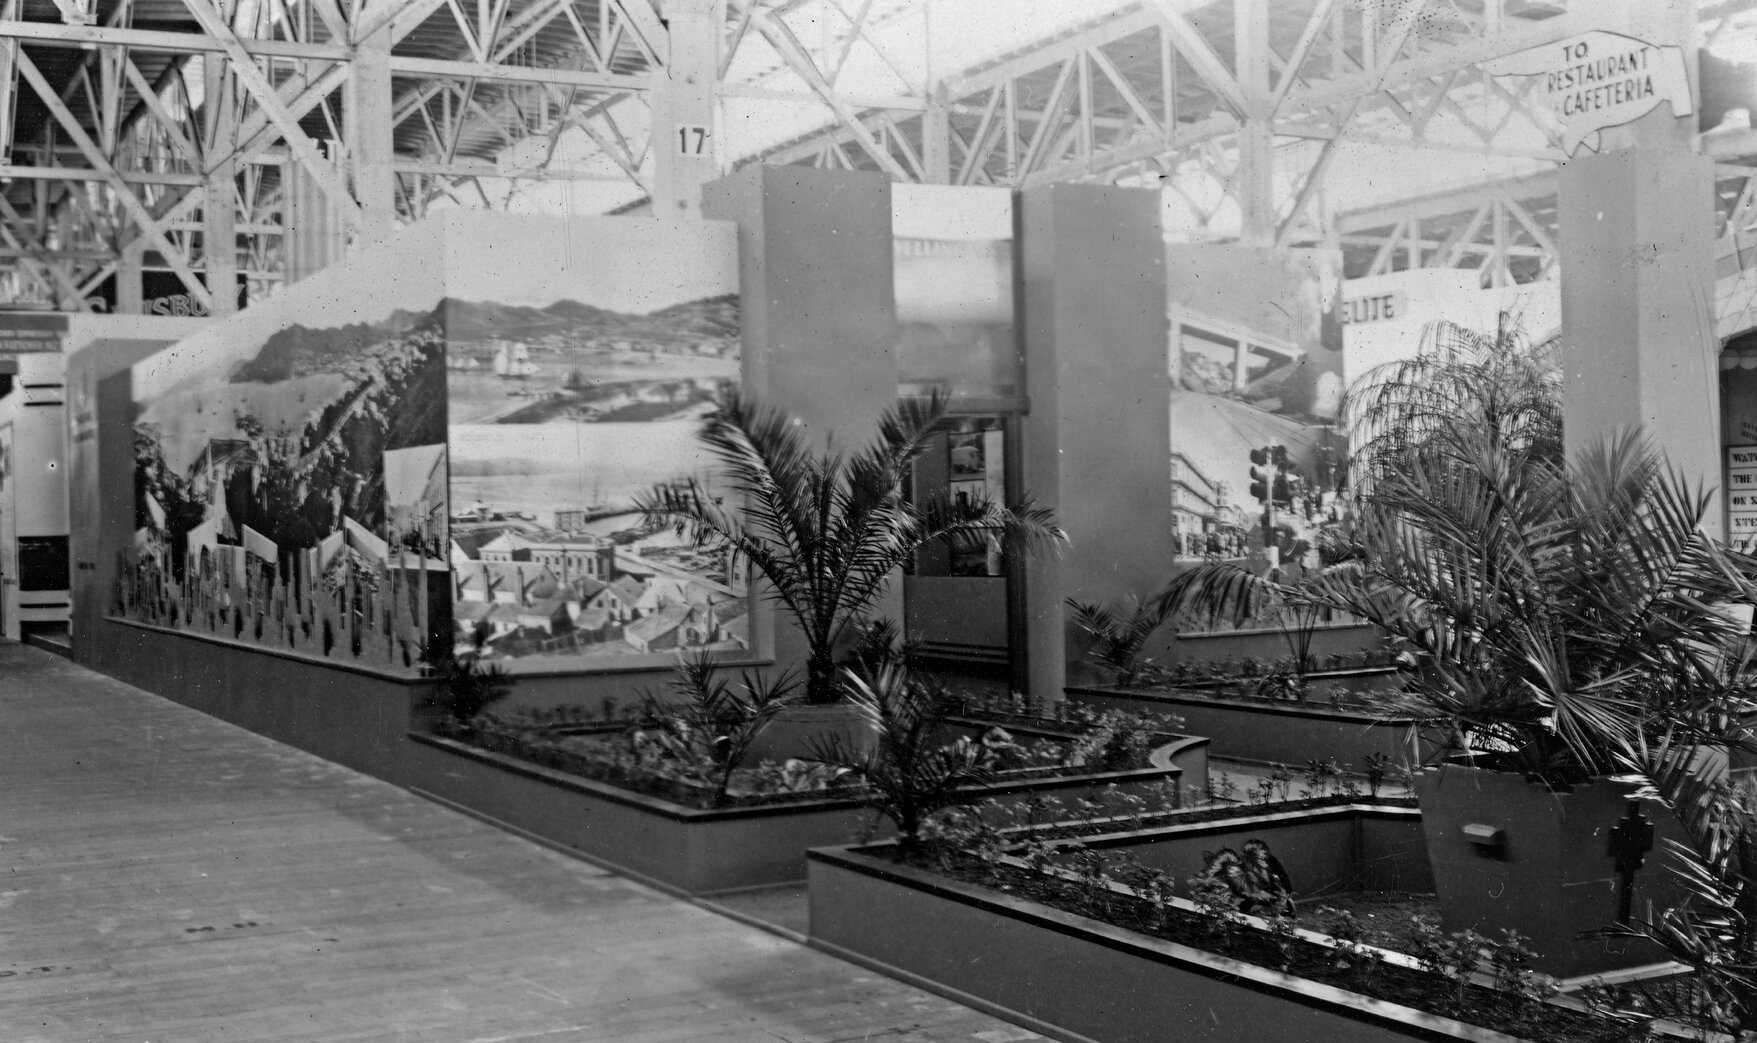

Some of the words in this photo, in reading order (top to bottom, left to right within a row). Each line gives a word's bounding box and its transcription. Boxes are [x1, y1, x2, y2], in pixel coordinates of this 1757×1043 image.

[1563, 42, 1588, 62] TO
[1548, 47, 1649, 94] RESTAURANT
[1564, 75, 1655, 116] CAFETERIA
[679, 126, 705, 154] 17
[1733, 474, 1753, 484] THE
